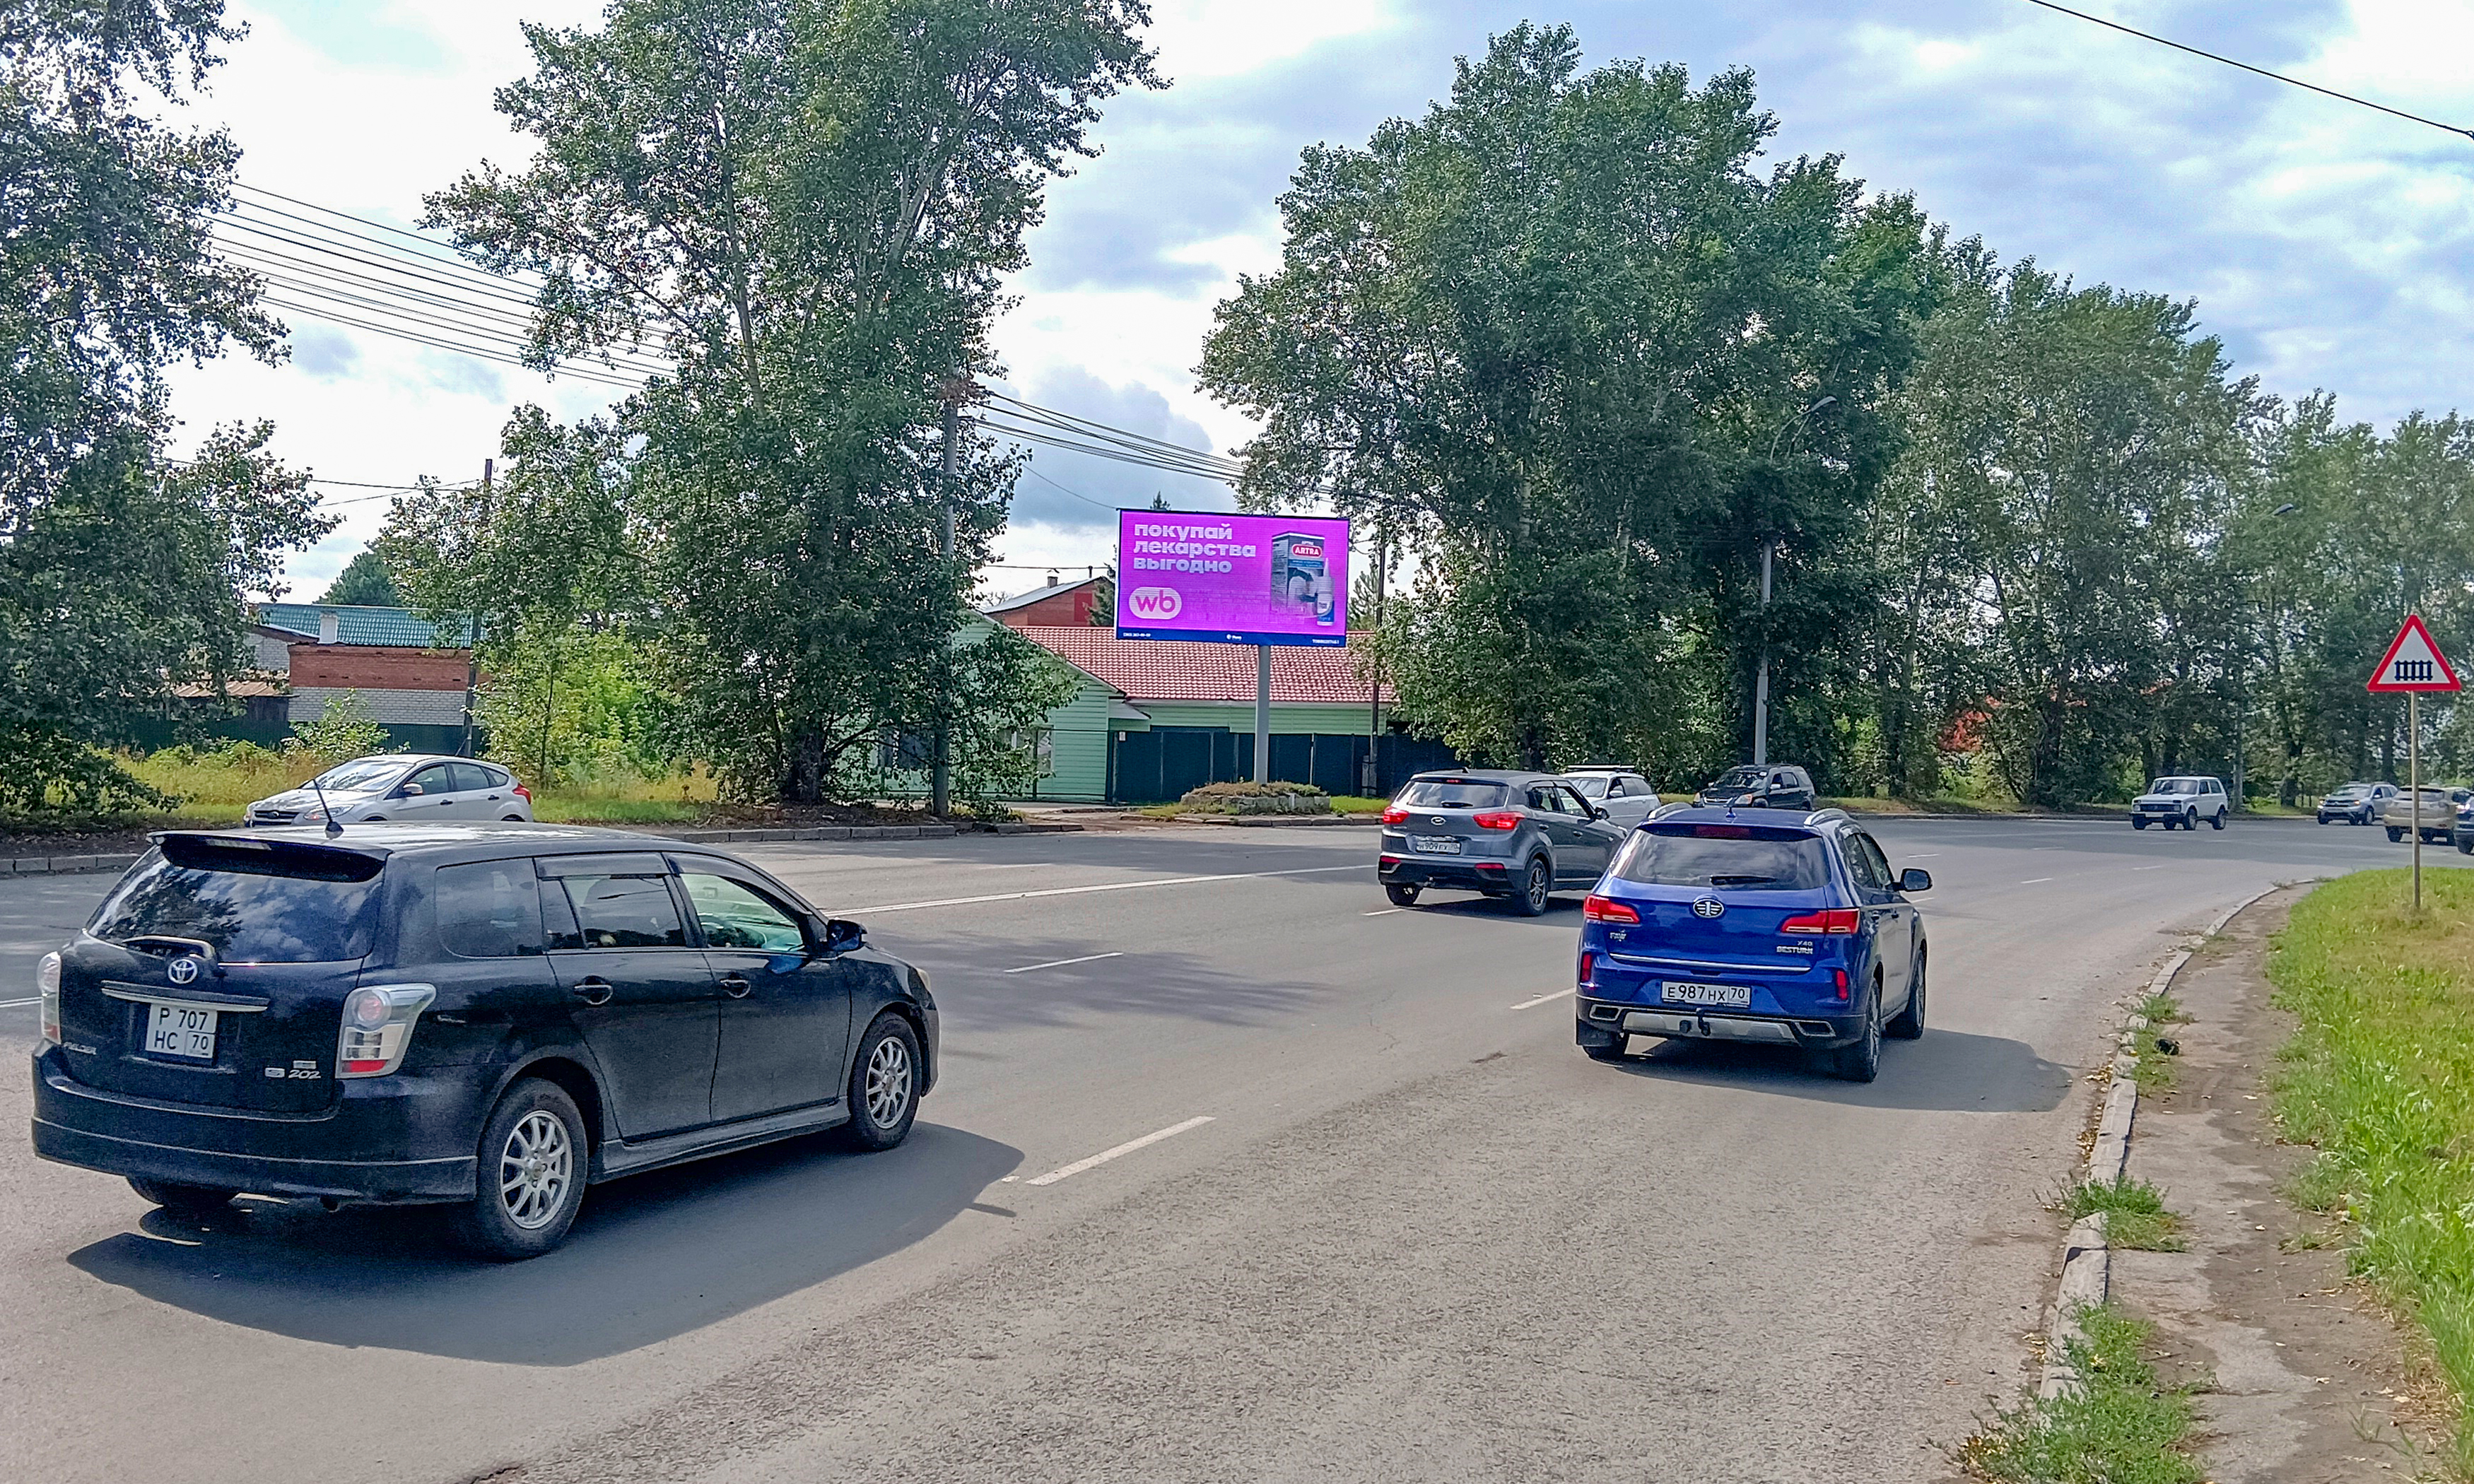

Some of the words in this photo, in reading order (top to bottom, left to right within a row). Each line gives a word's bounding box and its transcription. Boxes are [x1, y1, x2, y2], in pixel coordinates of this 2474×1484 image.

[1134, 523, 1232, 542] покупай
[1133, 541, 1256, 558] лекарства
[1294, 546, 1320, 555] ARTRA
[1133, 558, 1232, 574] выгодно
[1135, 589, 1176, 613] wb
[1730, 987, 1745, 999] 70
[178, 1008, 208, 1031] 707
[154, 1030, 178, 1050] НС
[192, 1034, 209, 1050] 70
[288, 1069, 322, 1080] 202
